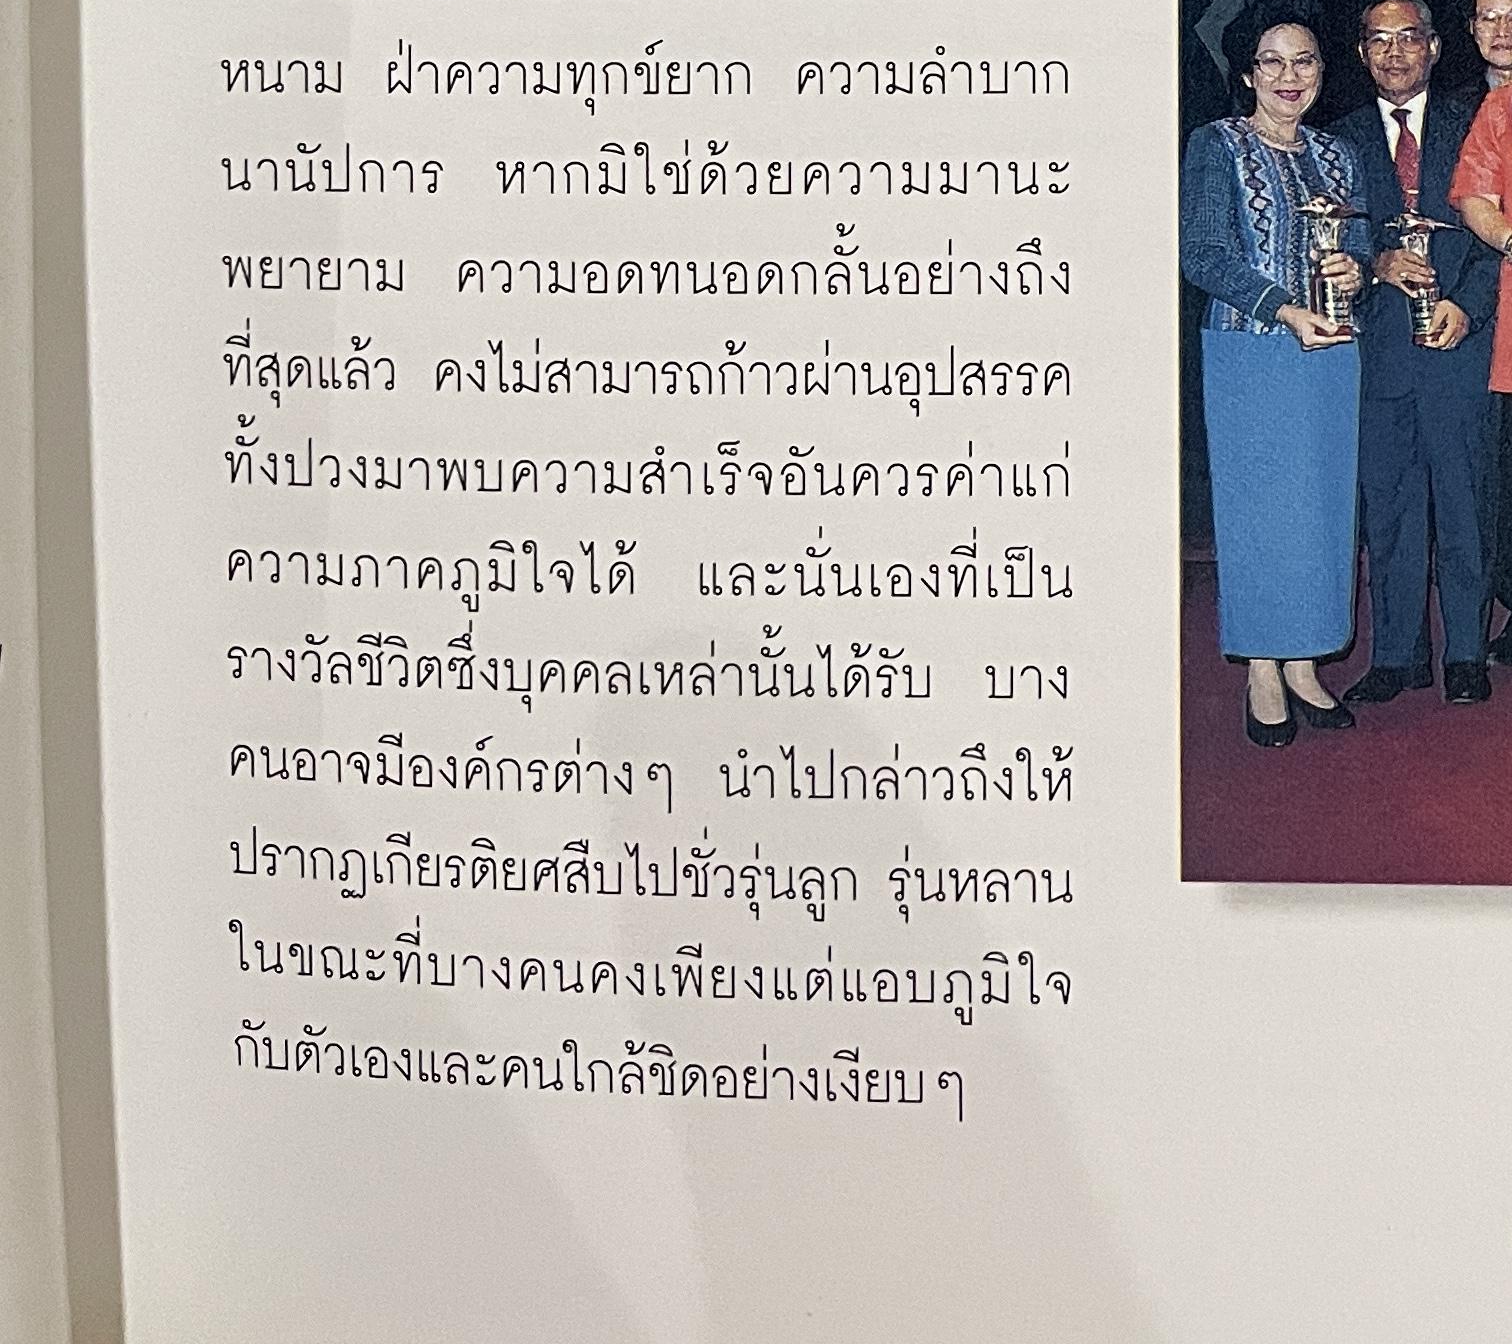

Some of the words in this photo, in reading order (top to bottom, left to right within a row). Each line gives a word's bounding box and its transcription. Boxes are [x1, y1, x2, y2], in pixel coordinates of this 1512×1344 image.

[220, 59, 342, 94] หนาม
[387, 38, 751, 117] ฝ่าความทุกข์ยาก
[797, 45, 1069, 96] ความลำบาก
[220, 142, 444, 194] นานัปการ
[495, 138, 1070, 196] หากมิใช่ด้วยความมานะ
[221, 255, 404, 292] พยายาม
[458, 222, 1070, 296] ความอดทนอดกลั้นอย่างถึง
[222, 316, 395, 409] ที่สุดแล้ว
[435, 337, 1071, 418] คงไม่สามารถก้าวผ่านอุปสรรค
[224, 413, 1070, 498] ทั้งปวงมาพบความสำเร็จอันควรค่าแก่
[227, 539, 637, 613] ความภาคภูมิใจได้
[699, 525, 1073, 599] และนั่นเองที่เป็น
[226, 619, 931, 714] รางวัลชีวิตซึ่งบุคคลเหล่านั้นได้รับ
[984, 664, 1068, 700] บาง
[718, 741, 1074, 803] นำไปกล่าวถึงให้
[229, 825, 857, 929] ปรากฏเกียรติยศสืบไปชั่วรุ่นลูก
[888, 844, 1074, 925] รุ่นหลาน
[228, 916, 1071, 1031] ในขณะที่บางคนคงเพียงแต่แอบภูมิใจ
